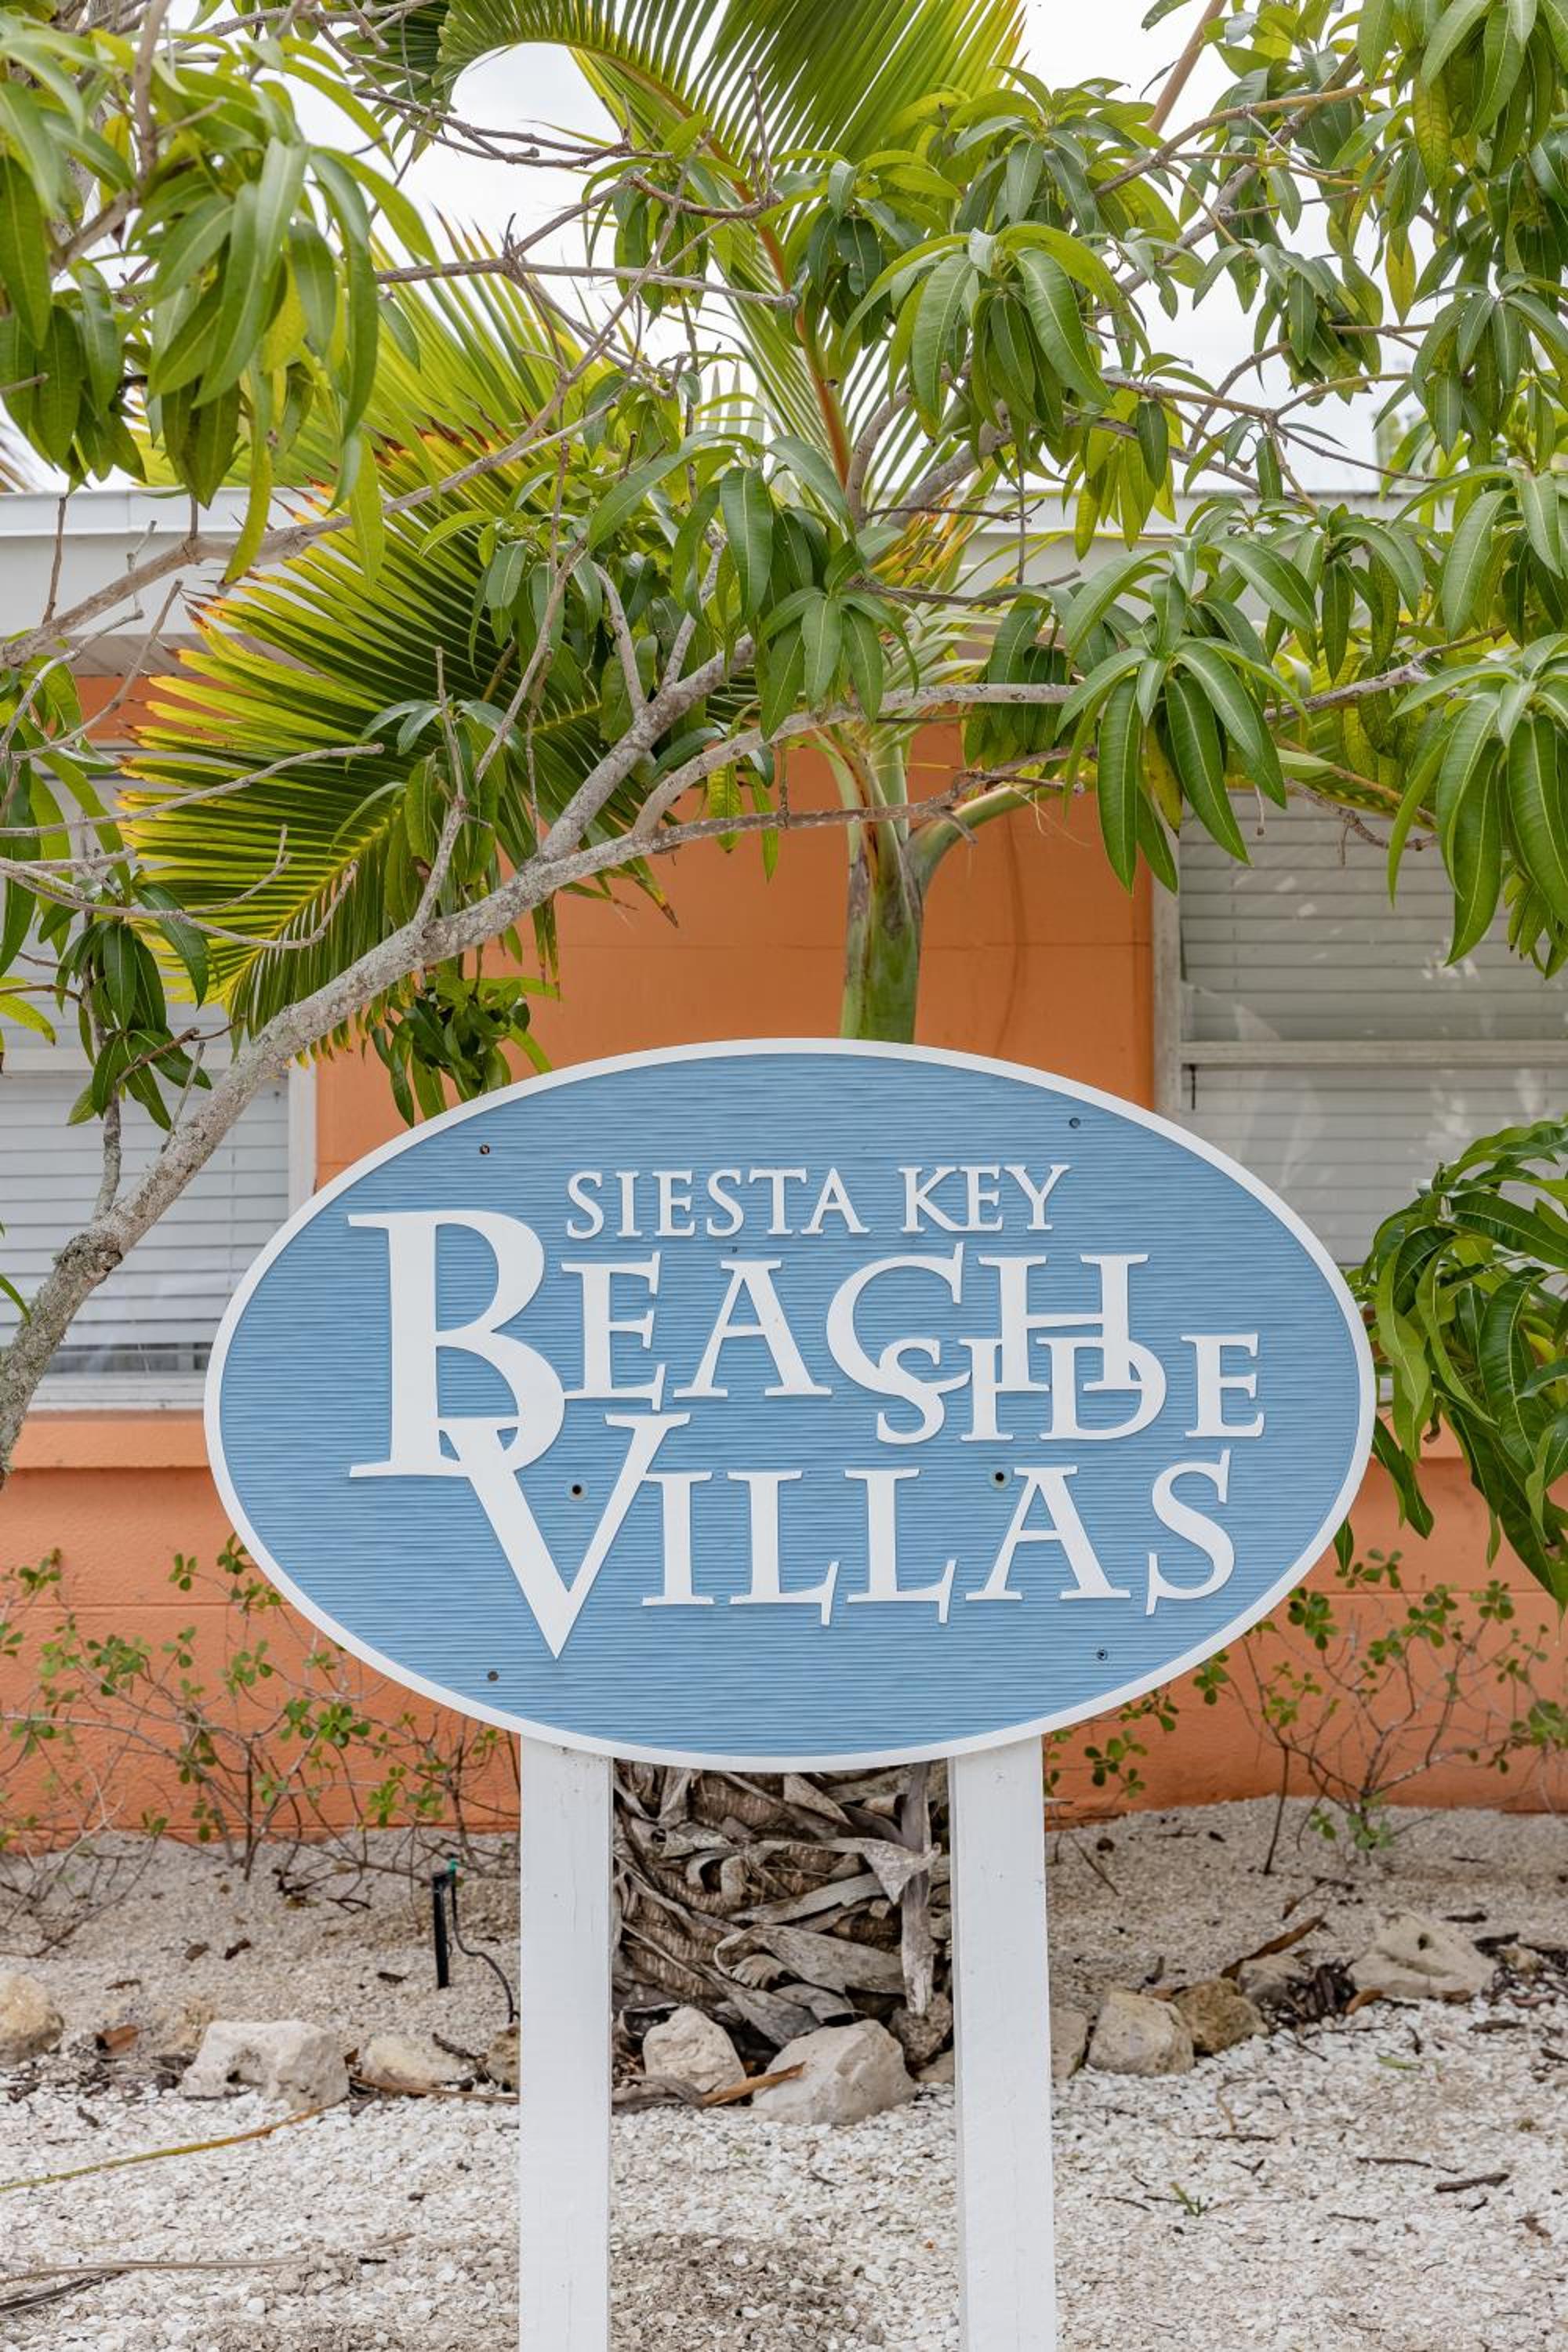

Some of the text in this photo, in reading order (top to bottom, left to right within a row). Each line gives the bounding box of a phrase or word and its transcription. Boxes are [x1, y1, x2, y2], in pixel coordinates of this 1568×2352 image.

[564, 1163, 1071, 1240] SIESTA KEY
[437, 1413, 1236, 1660] VILLAS
